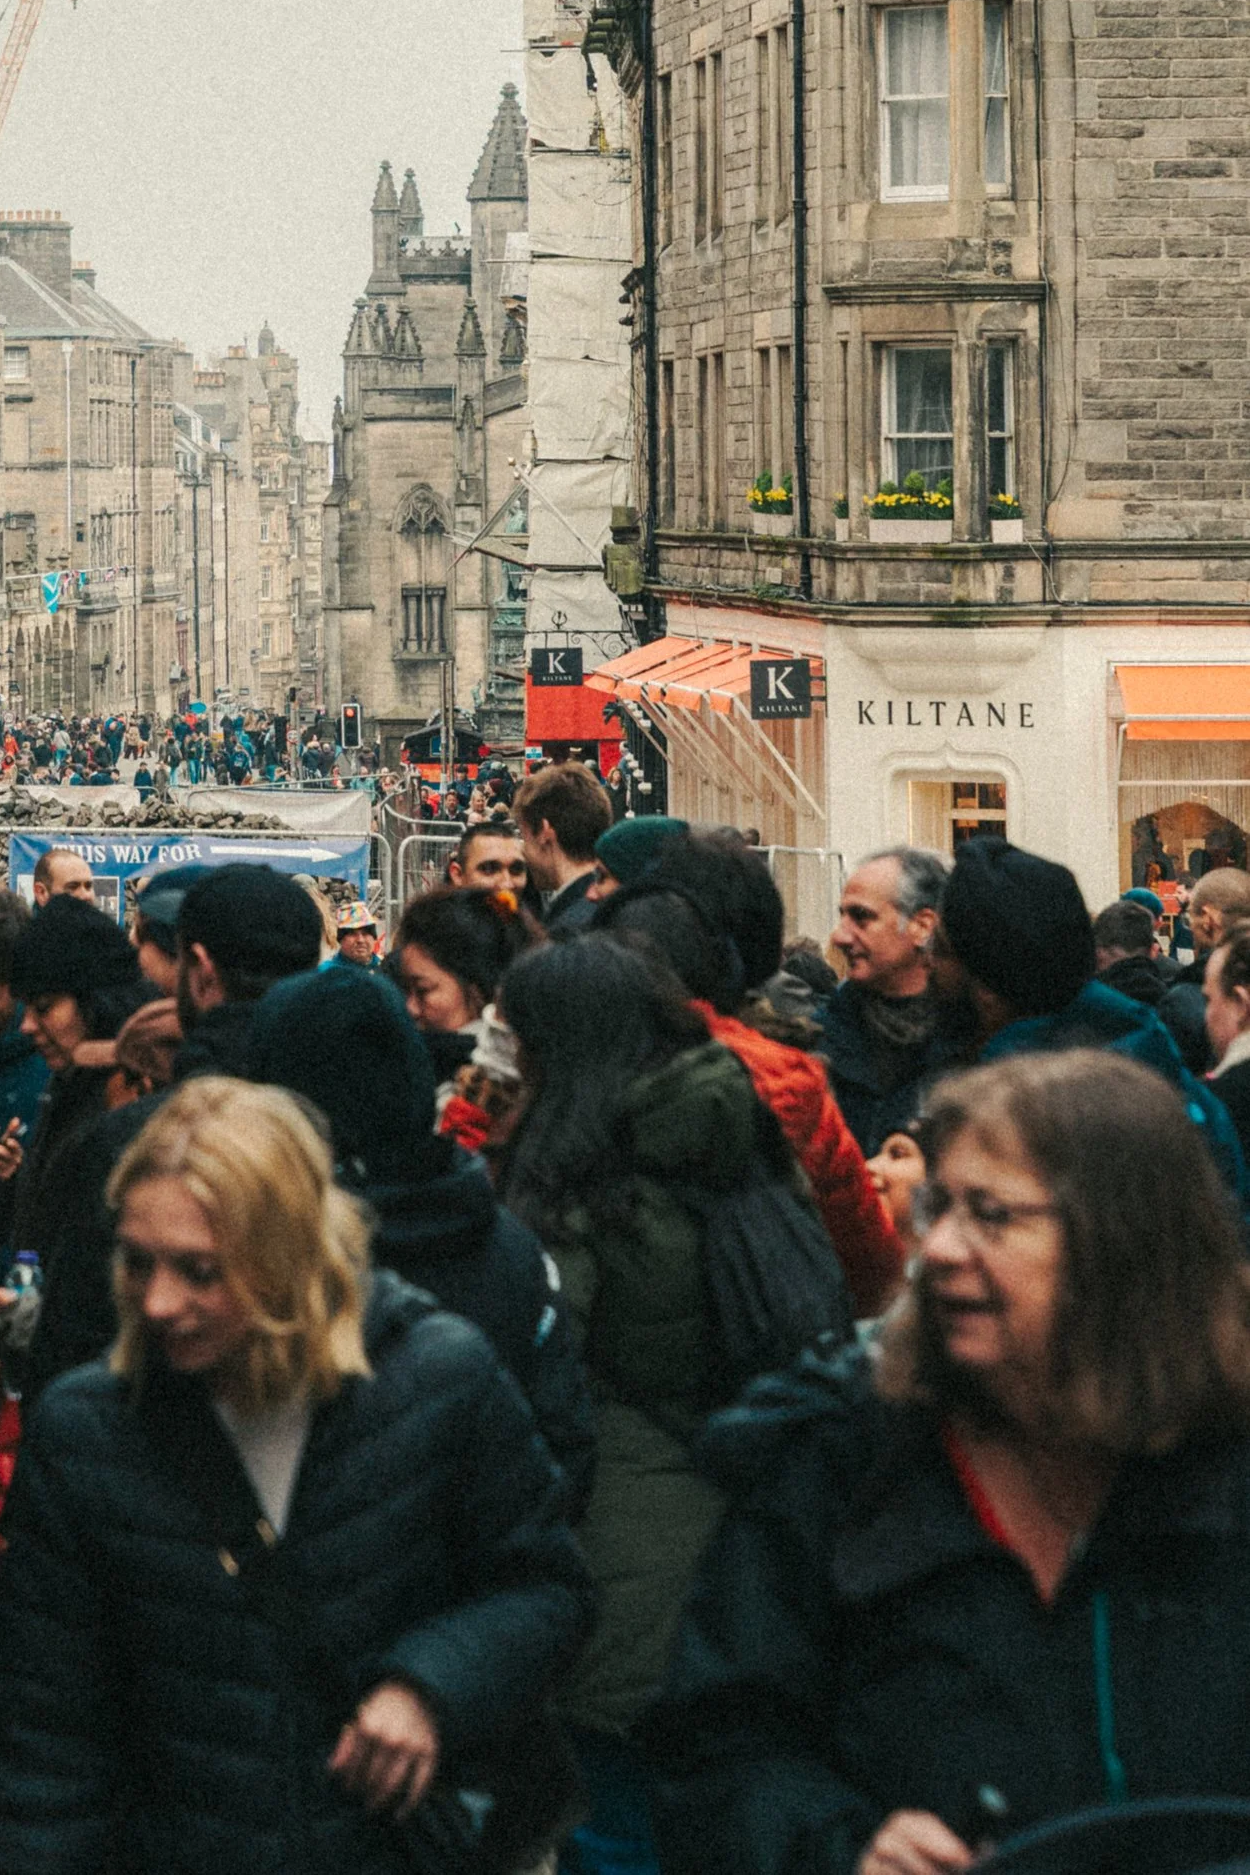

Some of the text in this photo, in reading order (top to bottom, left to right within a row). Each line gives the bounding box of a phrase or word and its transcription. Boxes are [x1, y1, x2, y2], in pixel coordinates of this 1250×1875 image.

[548, 652, 566, 674] K
[766, 666, 795, 700] K
[759, 704, 804, 713] KILTANE
[858, 700, 1035, 728] KILTANE
[112, 844, 155, 864] WAY
[158, 842, 203, 863] FOR
